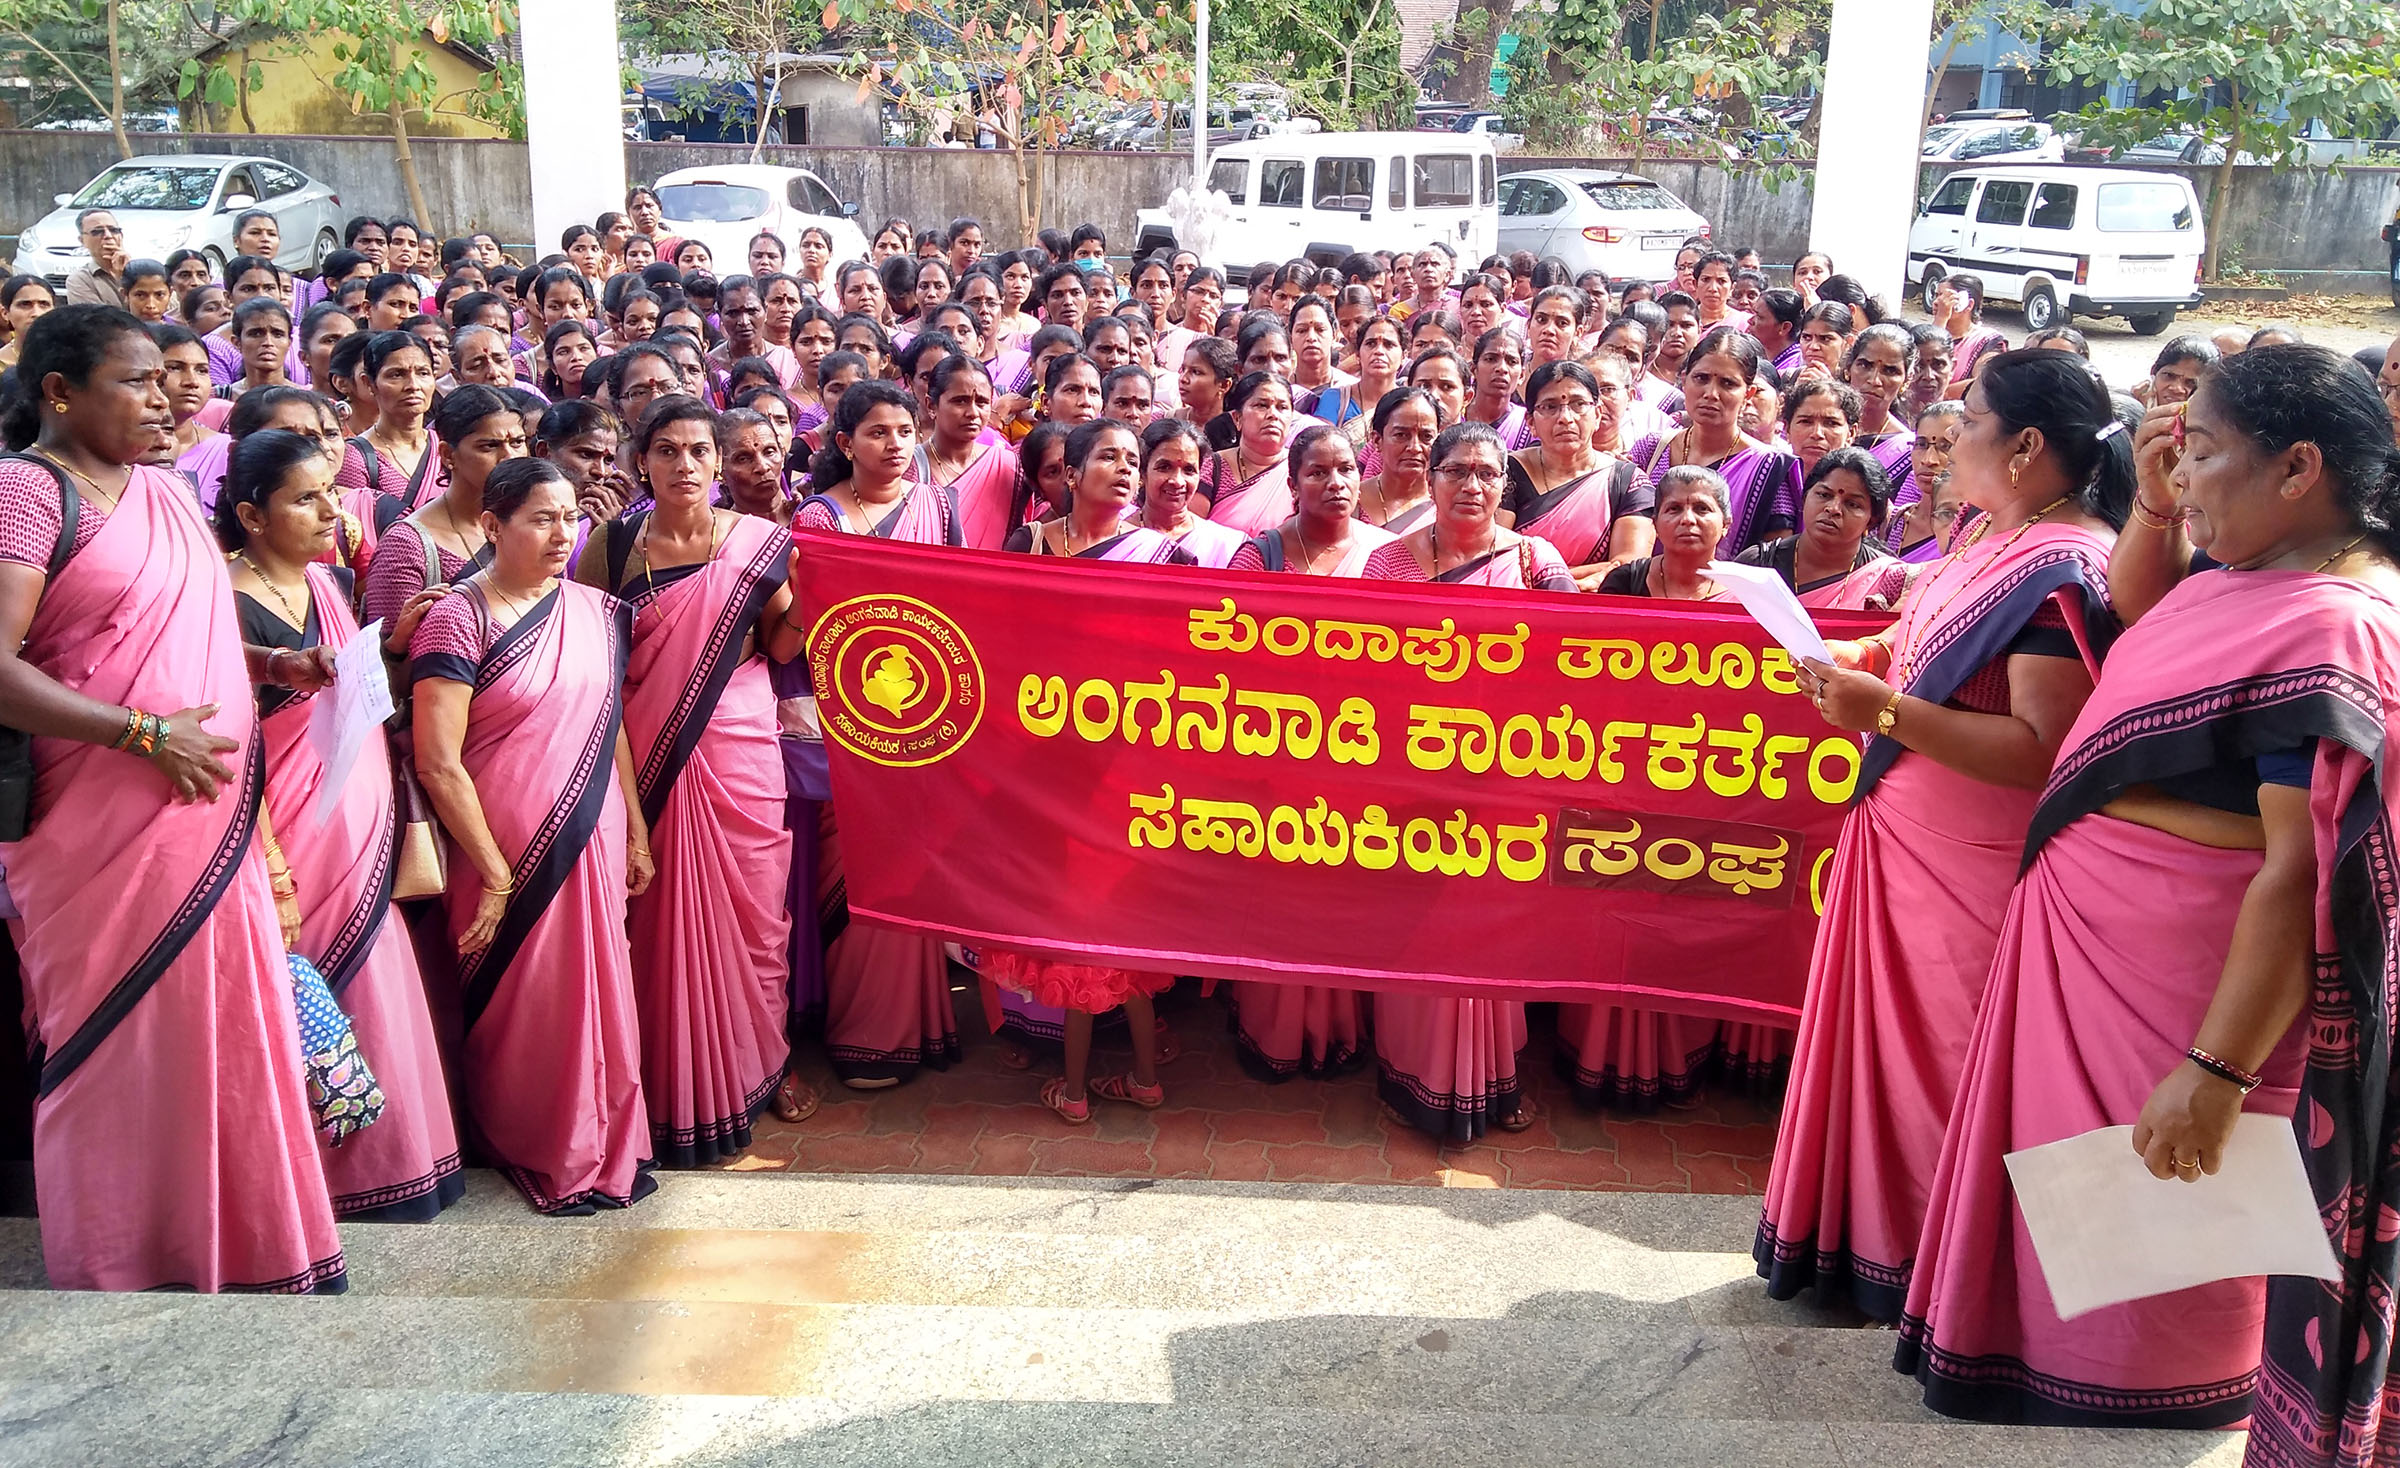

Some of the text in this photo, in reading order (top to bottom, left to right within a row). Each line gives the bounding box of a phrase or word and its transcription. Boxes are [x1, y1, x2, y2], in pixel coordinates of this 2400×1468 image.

[1187, 597, 1532, 684] ಕುಂದಾಪುರ
[1016, 668, 1382, 767] ಅಂಗನವಾಡಿ
[1127, 782, 1549, 883] ಸಹಾಯಕಿಯರ
[1562, 817, 1790, 896] ಸಂಘ
